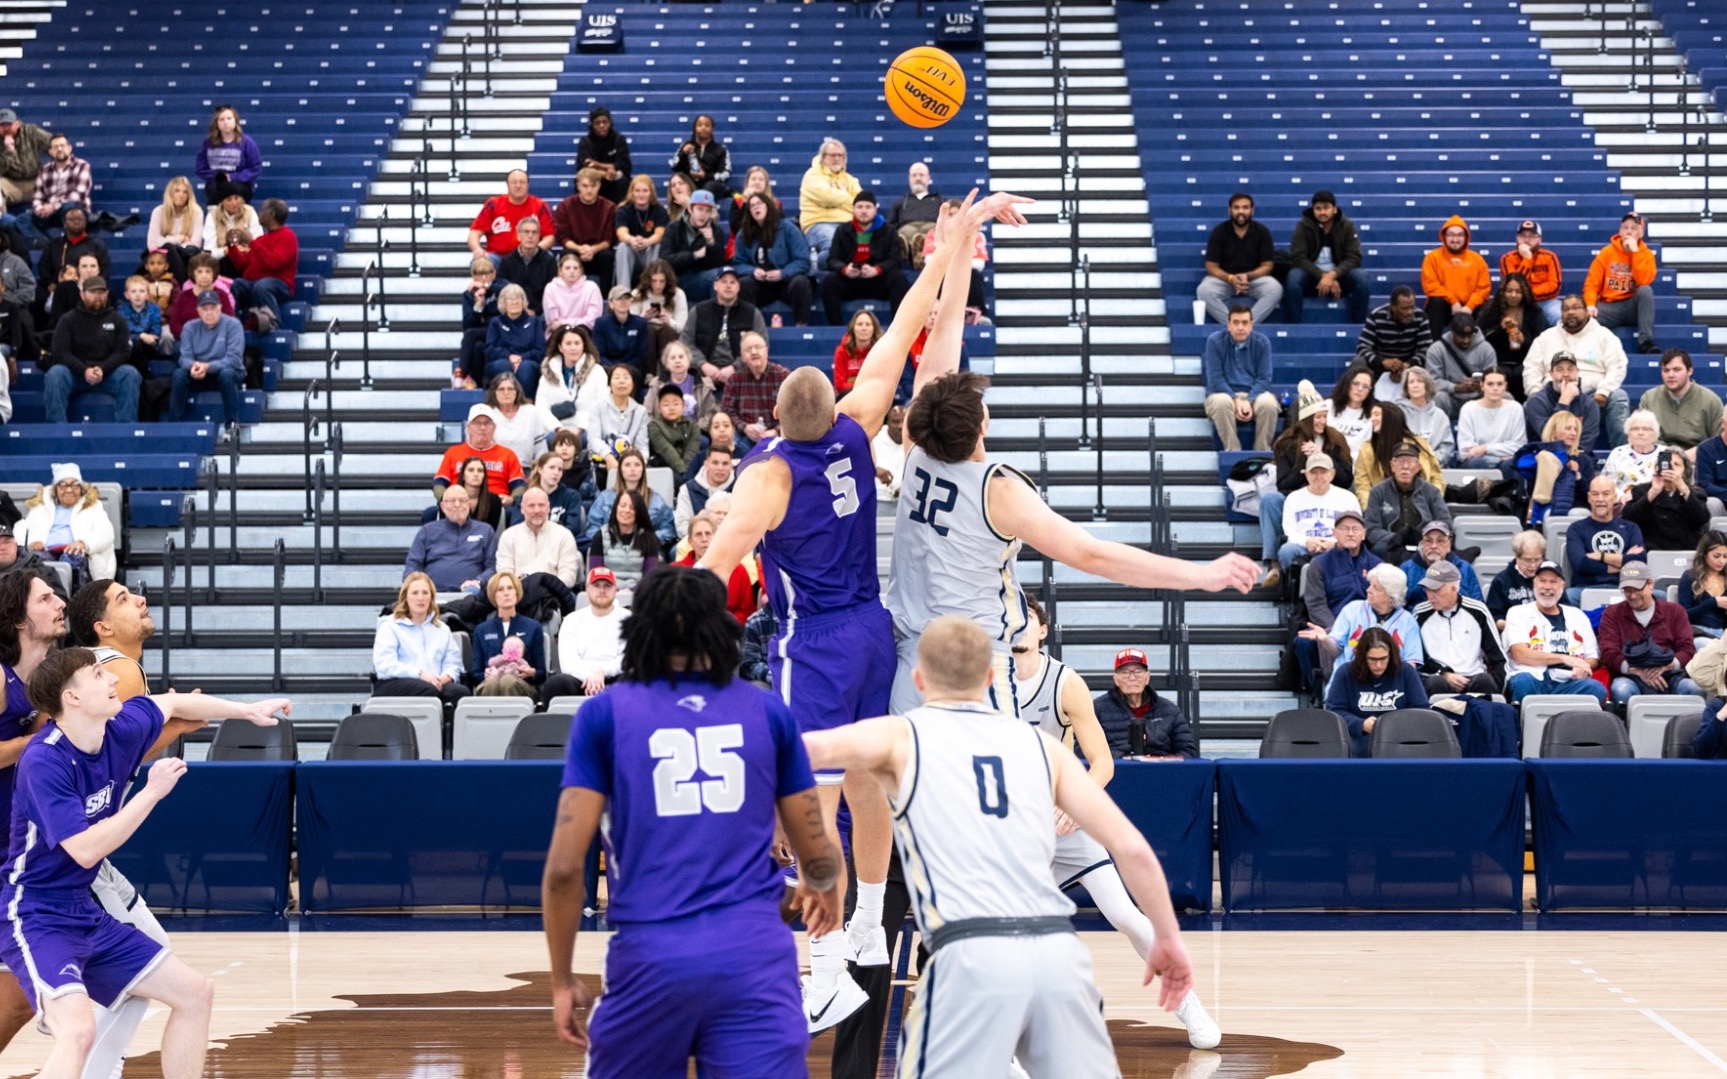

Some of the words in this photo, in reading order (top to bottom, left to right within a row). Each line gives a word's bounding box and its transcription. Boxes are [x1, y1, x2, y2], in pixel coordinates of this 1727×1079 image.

[588, 14, 617, 27] UIS
[945, 13, 974, 25] UIS
[904, 80, 950, 117] Wilson
[824, 457, 860, 518] 5
[909, 466, 959, 537] 32
[1358, 689, 1400, 707] UIS
[648, 723, 745, 817] 25
[972, 754, 1009, 819] 0
